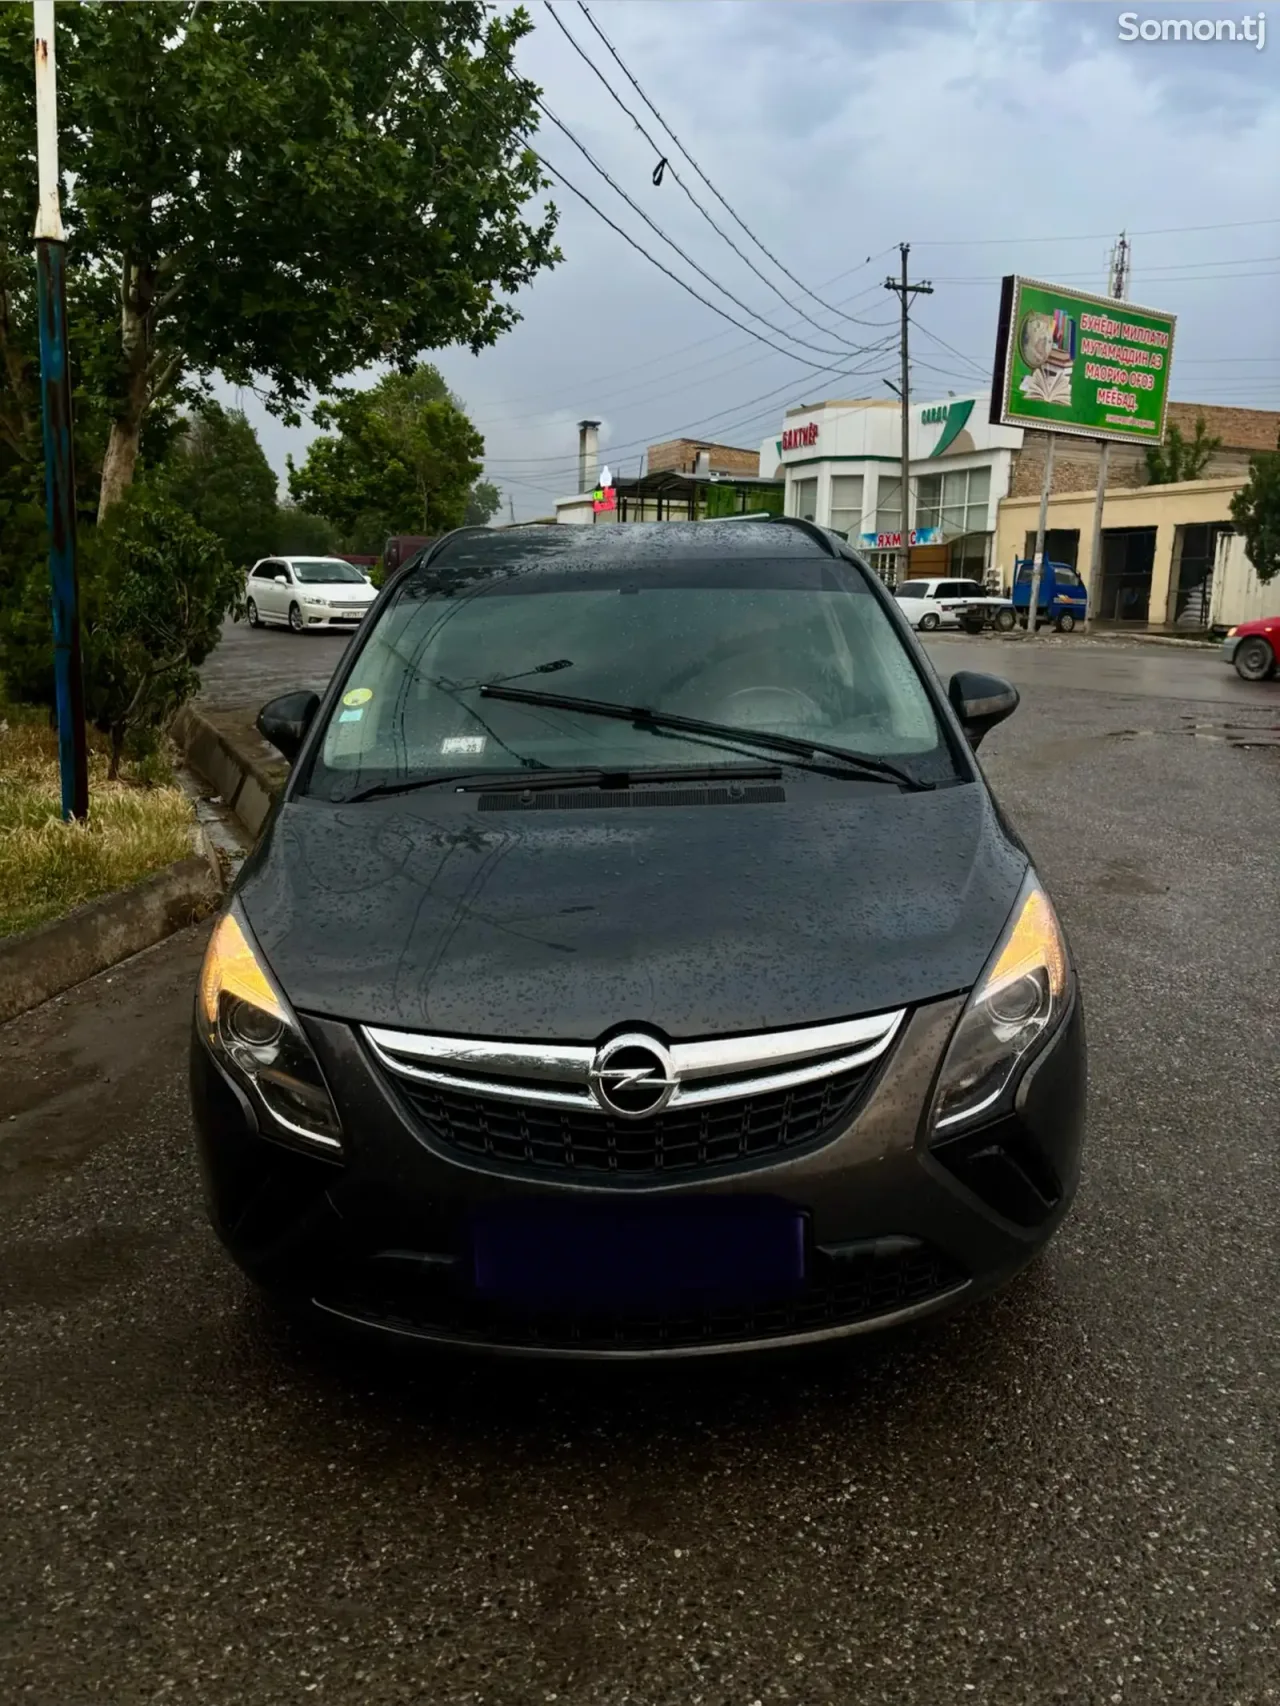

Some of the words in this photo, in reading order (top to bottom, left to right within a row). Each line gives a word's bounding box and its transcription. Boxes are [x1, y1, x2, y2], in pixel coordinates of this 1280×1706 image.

[1080, 314, 1120, 339] БУНЁДИ
[1122, 323, 1169, 348] МИЛЛАТИ
[1081, 338, 1149, 367] МУТАМАДДИН
[1149, 353, 1163, 370] АЗ
[1085, 362, 1129, 385] МАОРИФ
[877, 530, 917, 547] ЯХМС
